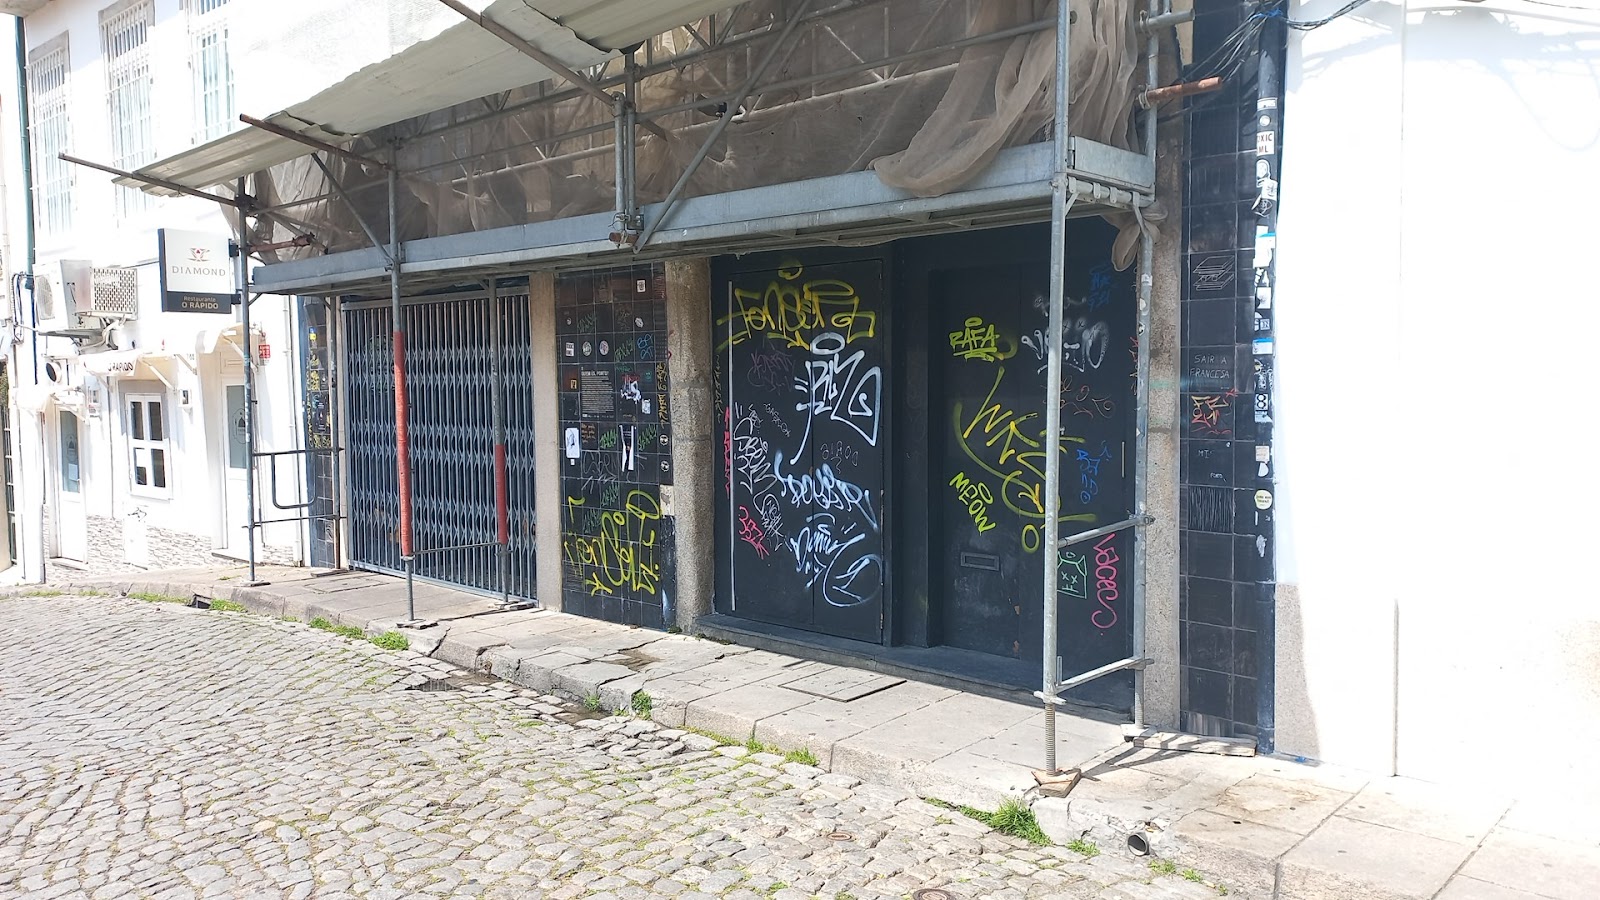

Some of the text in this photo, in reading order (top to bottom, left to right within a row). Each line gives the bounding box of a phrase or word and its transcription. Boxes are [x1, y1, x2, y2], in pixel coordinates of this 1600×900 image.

[171, 265, 226, 277] DIAMOND
[183, 295, 217, 303] Restaurante
[181, 301, 188, 309] O
